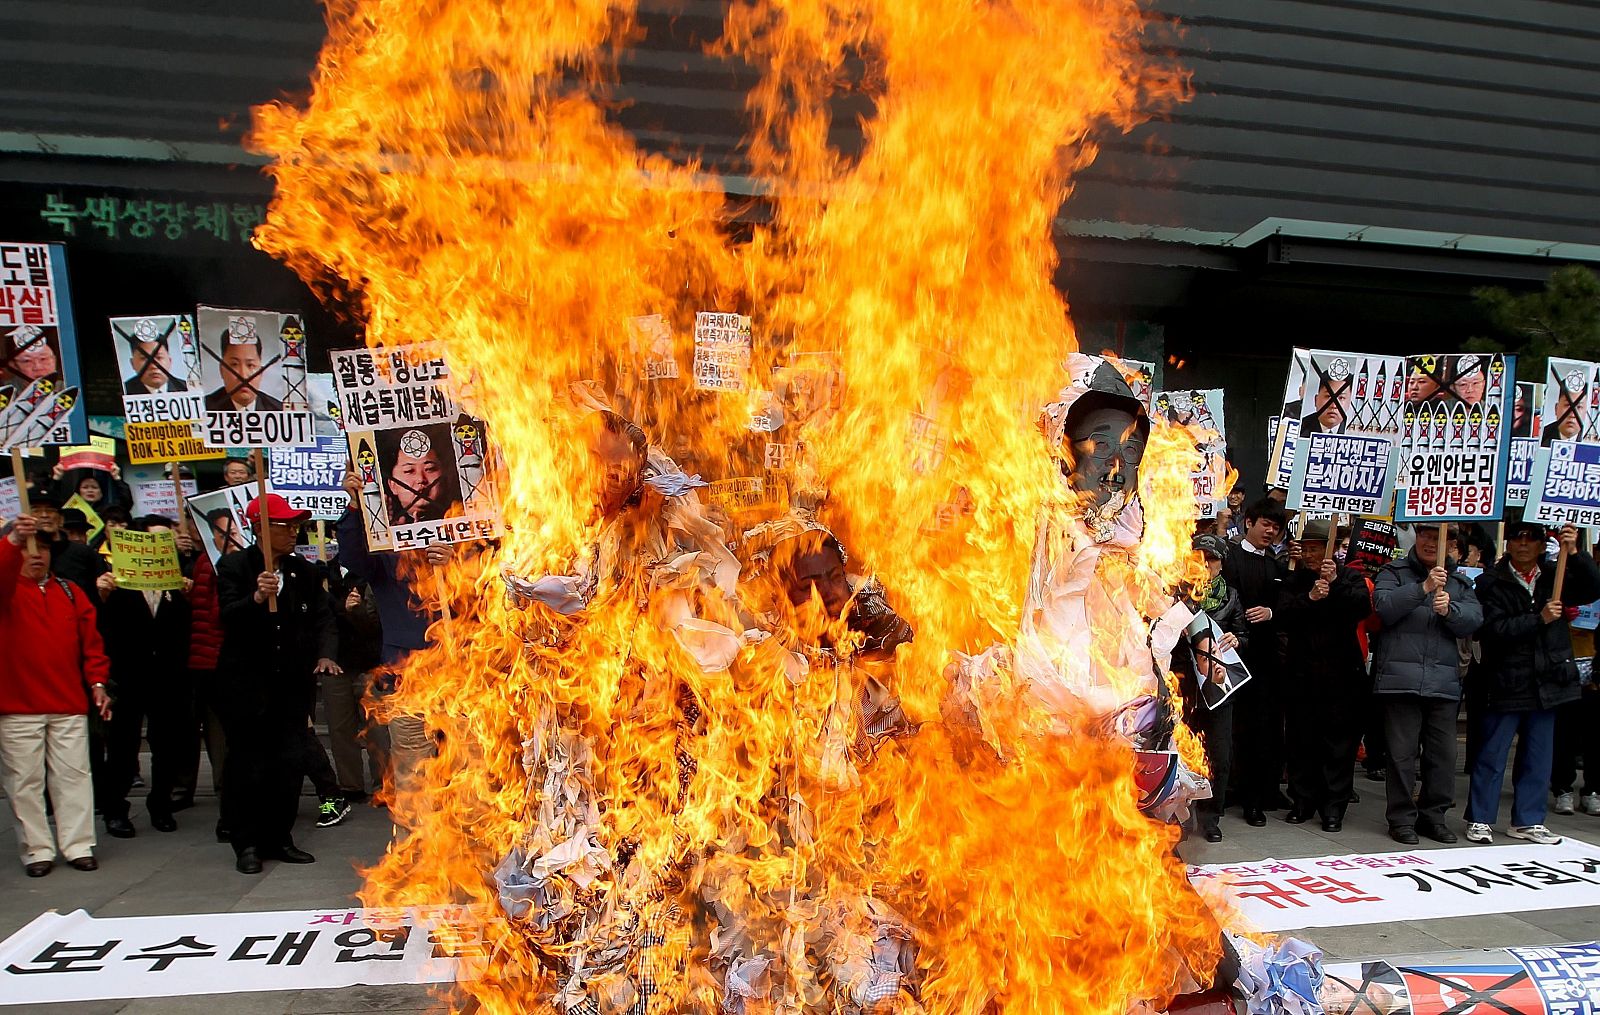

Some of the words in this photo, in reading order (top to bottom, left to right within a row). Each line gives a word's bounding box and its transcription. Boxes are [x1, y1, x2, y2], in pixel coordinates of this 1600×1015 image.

[1, 246, 50, 287] 도발
[346, 383, 454, 426] 세습독재분쇄!
[128, 422, 191, 441] Strengthen
[207, 412, 315, 444] 김정은OUT!
[131, 441, 177, 459] ROK-U.S.
[271, 452, 346, 470] 한미동맹
[1310, 436, 1391, 467] 북핵전쟁도발
[271, 468, 346, 487] 강화하자!
[1305, 462, 1387, 494] 분쇄하자!
[1409, 454, 1495, 486] 유엔안보리
[284, 496, 348, 510] 수대연합
[1302, 493, 1377, 513] 보수대연합
[1407, 485, 1493, 516] 북한강력응징
[395, 518, 494, 548] 보수대연합
[1363, 521, 1391, 534] 도발만
[1356, 541, 1390, 556] 지구에서
[1222, 875, 1385, 909] 규탄
